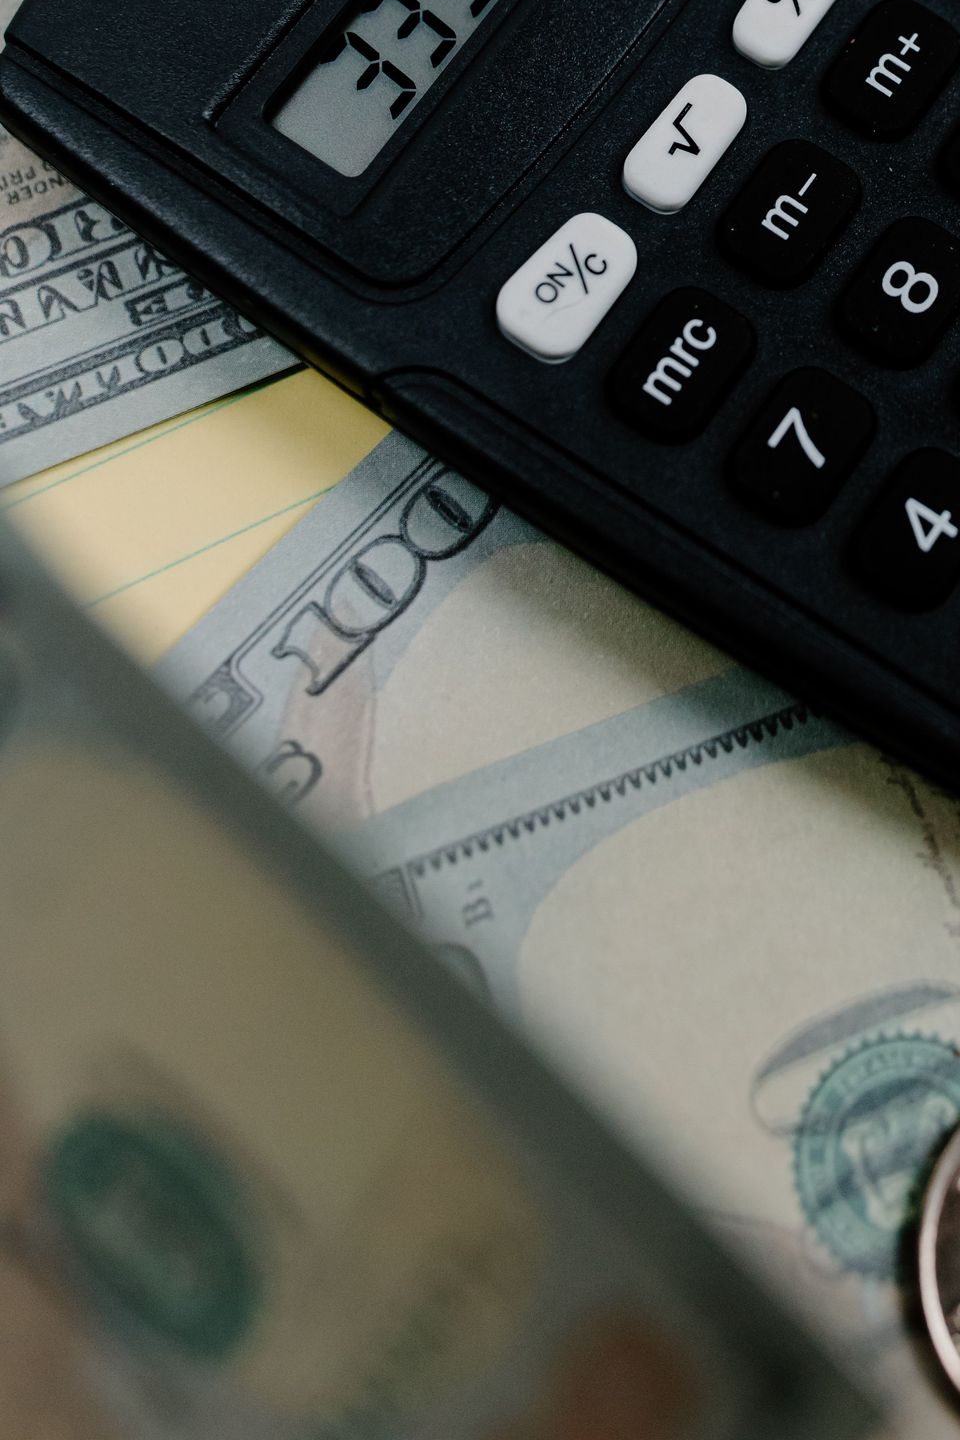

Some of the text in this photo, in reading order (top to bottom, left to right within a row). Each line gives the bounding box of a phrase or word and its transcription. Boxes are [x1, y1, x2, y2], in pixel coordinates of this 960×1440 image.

[865, 32, 921, 98] m+
[535, 243, 608, 304] ON/C
[881, 260, 939, 314] 8
[642, 318, 718, 406] mrc
[767, 407, 826, 469] 7
[905, 497, 959, 553] 4
[270, 465, 503, 697] 100
